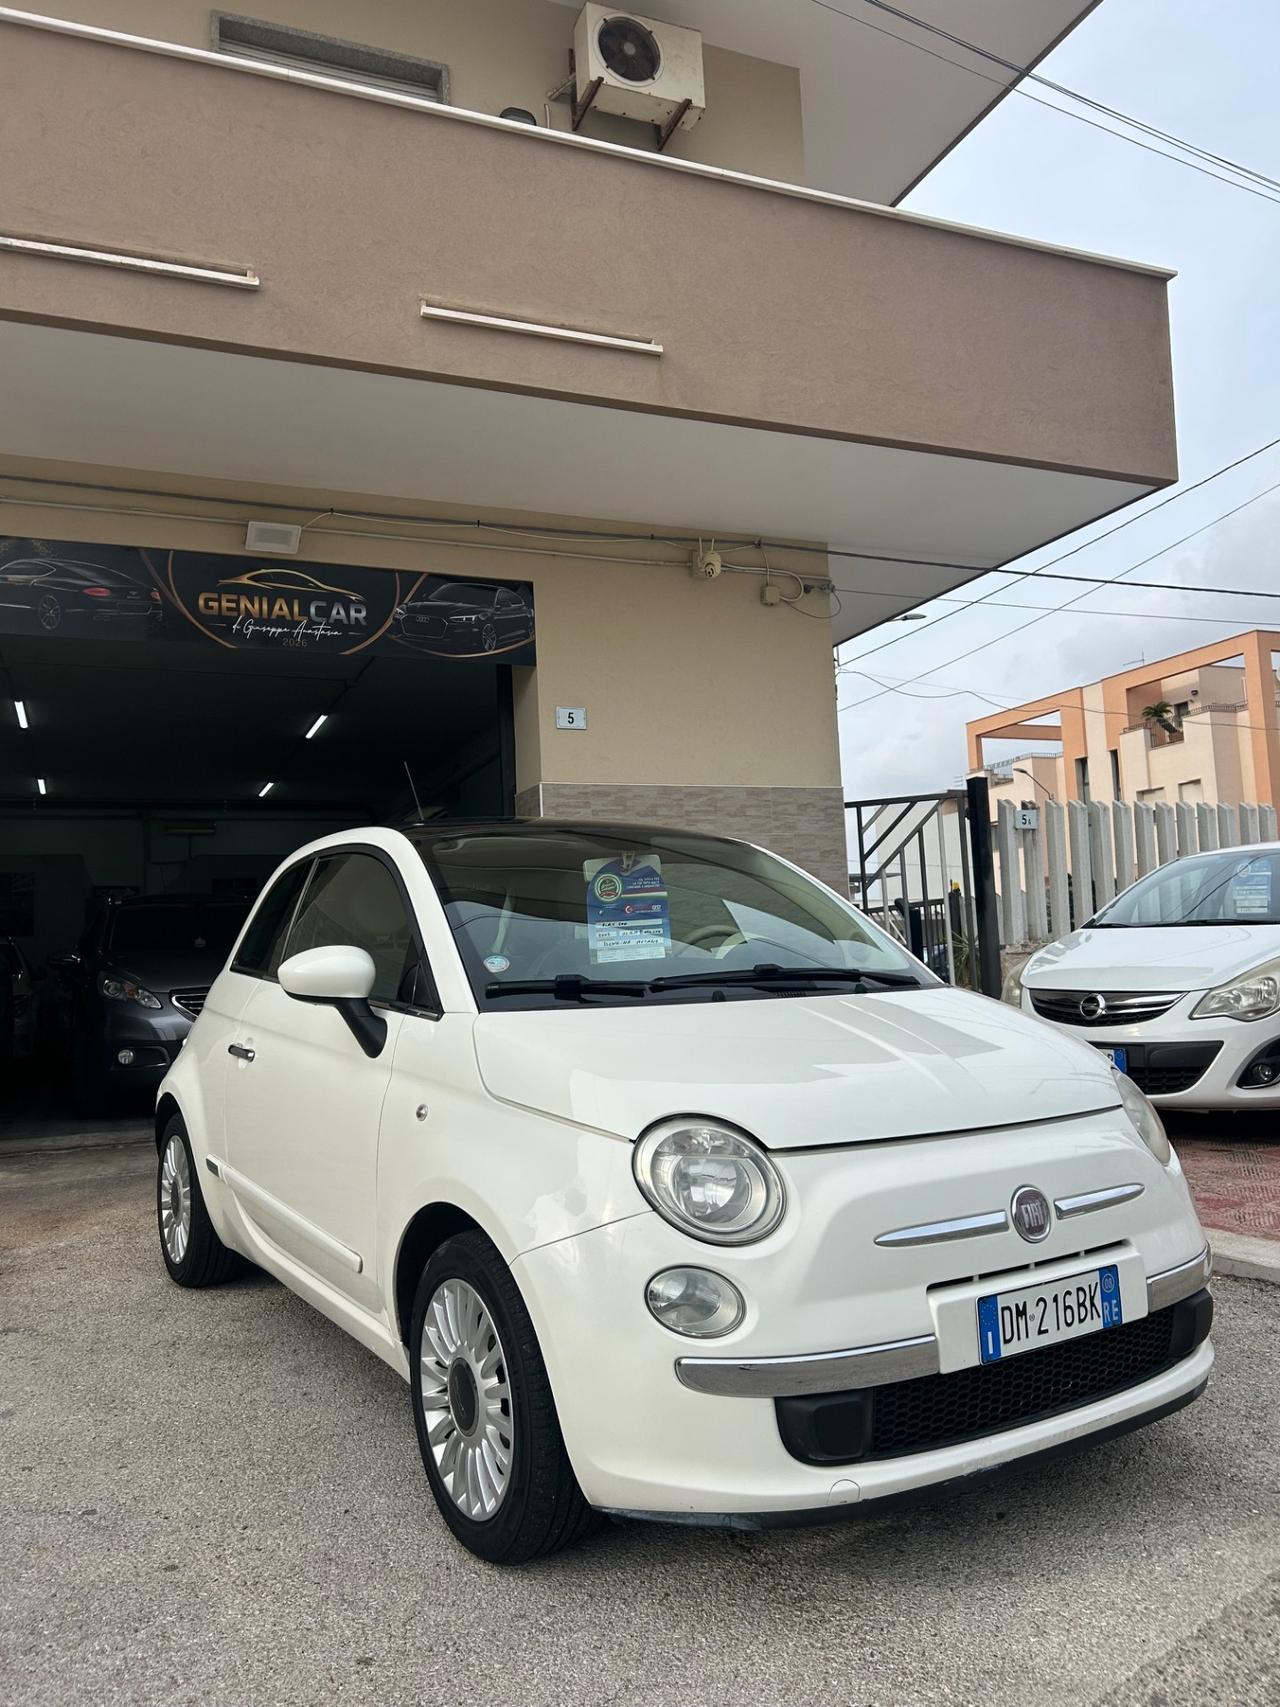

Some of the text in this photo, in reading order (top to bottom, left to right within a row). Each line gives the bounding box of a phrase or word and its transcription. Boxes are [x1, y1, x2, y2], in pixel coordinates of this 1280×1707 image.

[243, 618, 290, 639] Giuseppe
[292, 619, 342, 641] Anastasia
[282, 637, 308, 647] 2026
[567, 711, 575, 724] 5
[1020, 1201, 1047, 1229] FIAT
[1103, 1299, 1120, 1323] RE
